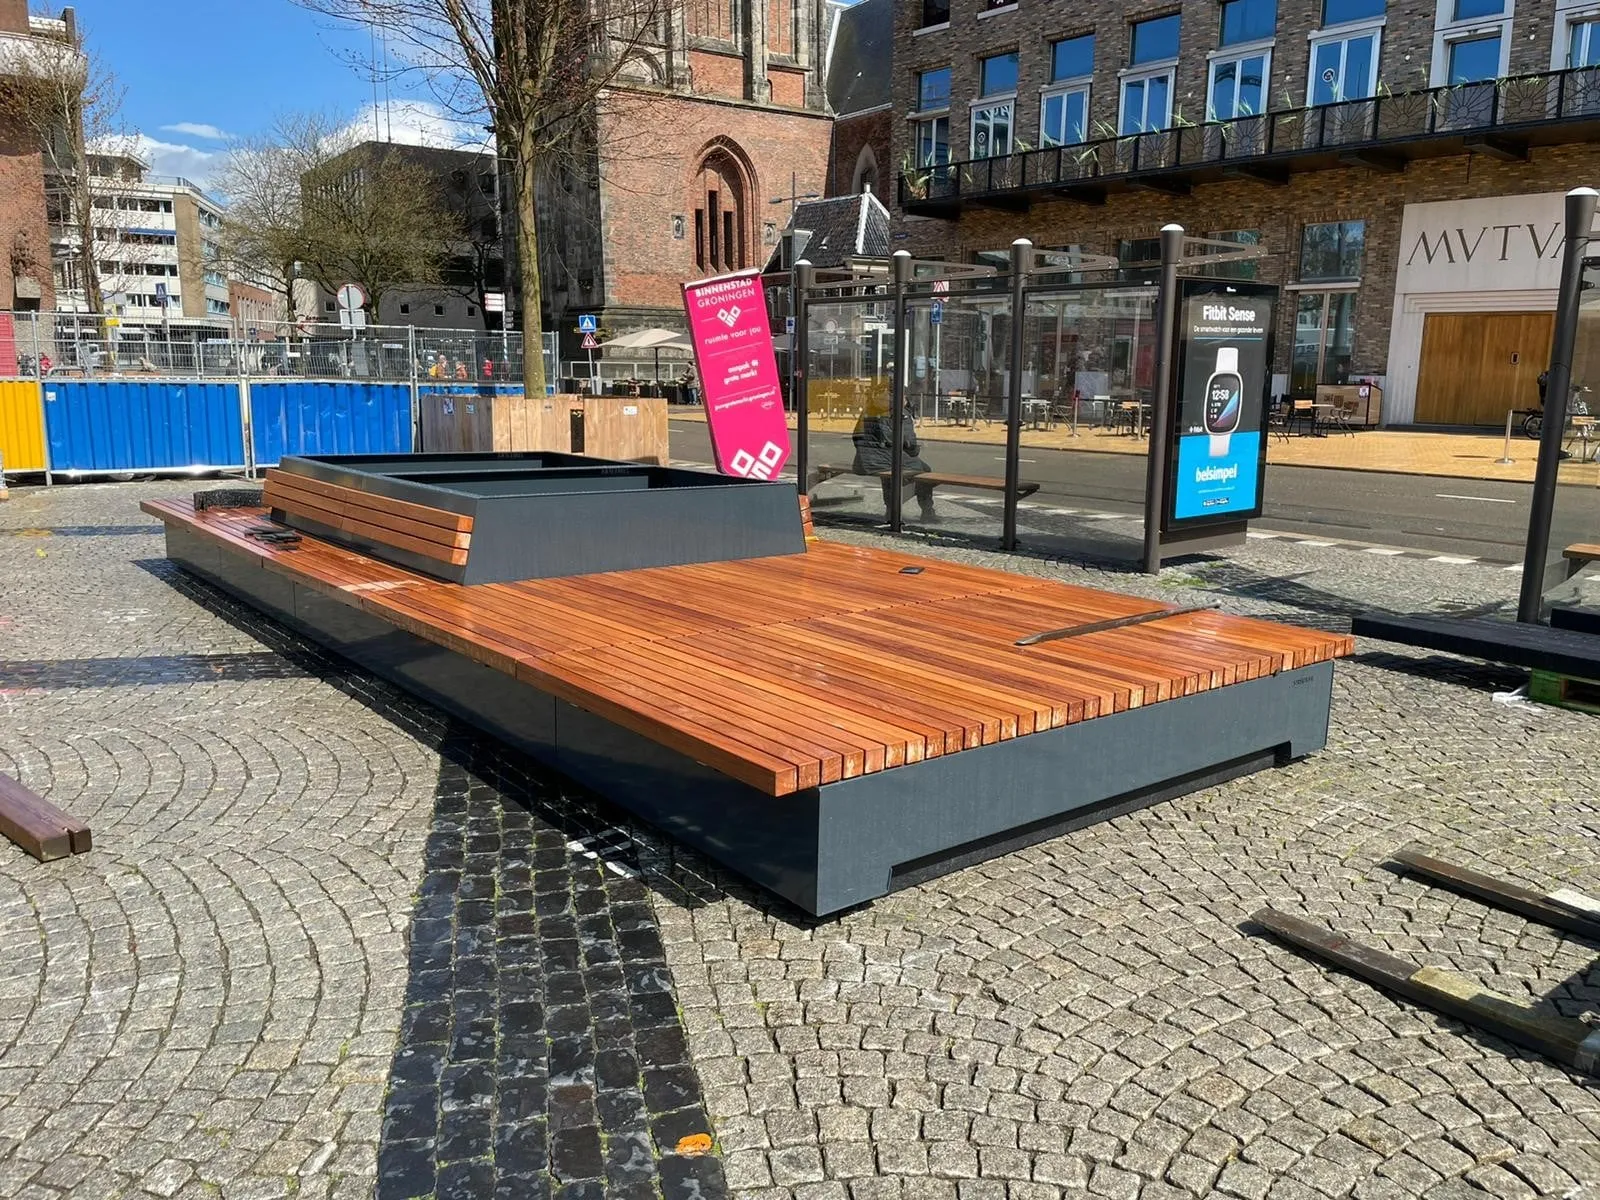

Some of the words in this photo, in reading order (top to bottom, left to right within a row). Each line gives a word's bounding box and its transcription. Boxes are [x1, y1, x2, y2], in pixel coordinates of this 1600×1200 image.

[1405, 222, 1566, 266] MVTV
[695, 278, 753, 298] BINNENSTAD
[697, 288, 755, 308] GRONINGEN
[1203, 305, 1228, 321] Fitbit
[1228, 306, 1256, 322] Sense
[704, 333, 729, 345] ruimte
[730, 329, 747, 340] voor
[749, 326, 762, 337] jou
[1193, 325, 1200, 333] De
[1195, 462, 1239, 484] belsimpel
